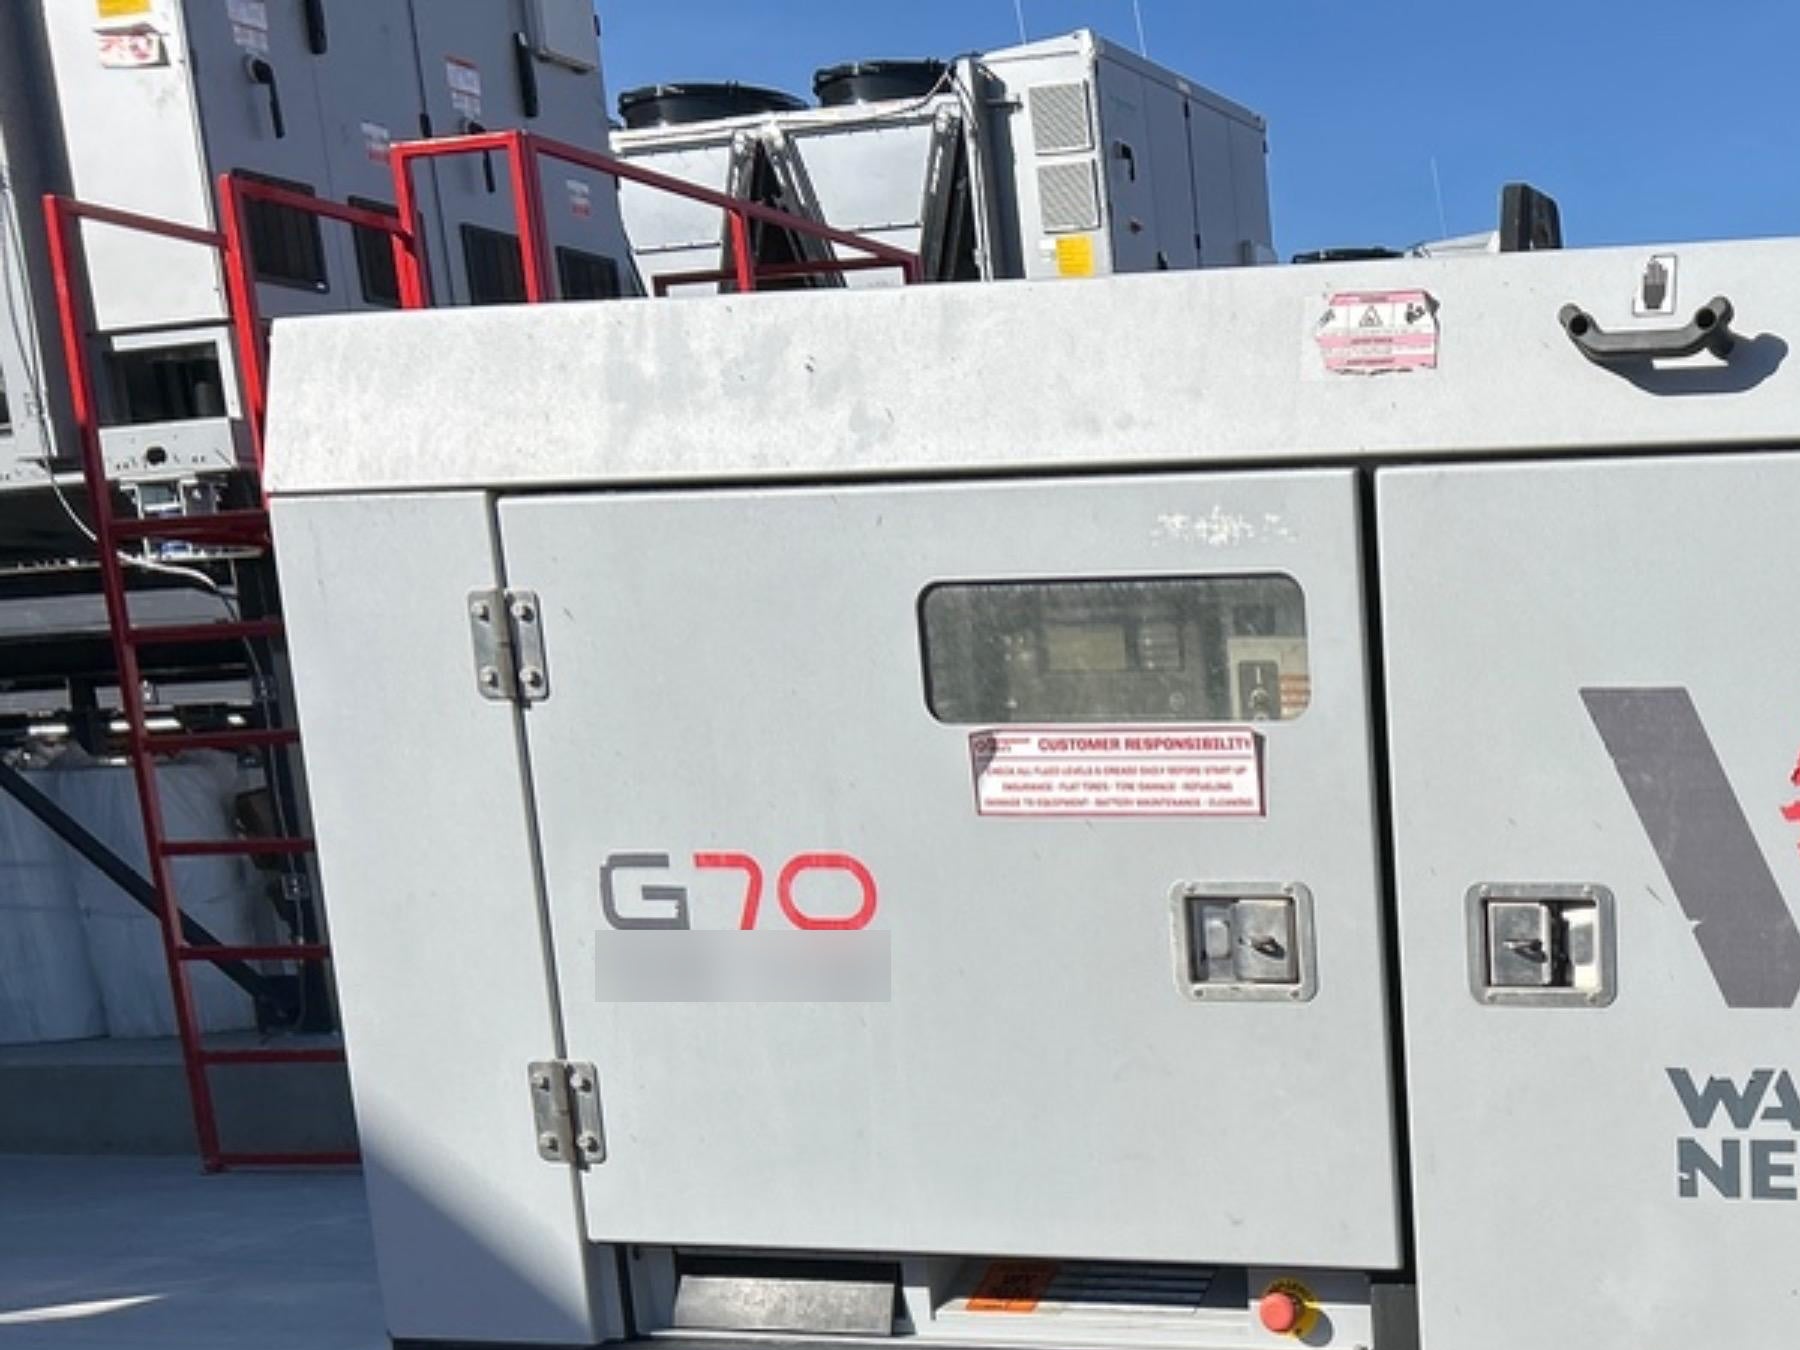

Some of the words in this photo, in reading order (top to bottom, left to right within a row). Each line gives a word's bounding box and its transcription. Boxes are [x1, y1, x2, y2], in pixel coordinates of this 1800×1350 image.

[1038, 737, 1121, 752] CUSTOMER
[1125, 736, 1252, 751] RESPONSIBILITY
[600, 853, 878, 931] G70
